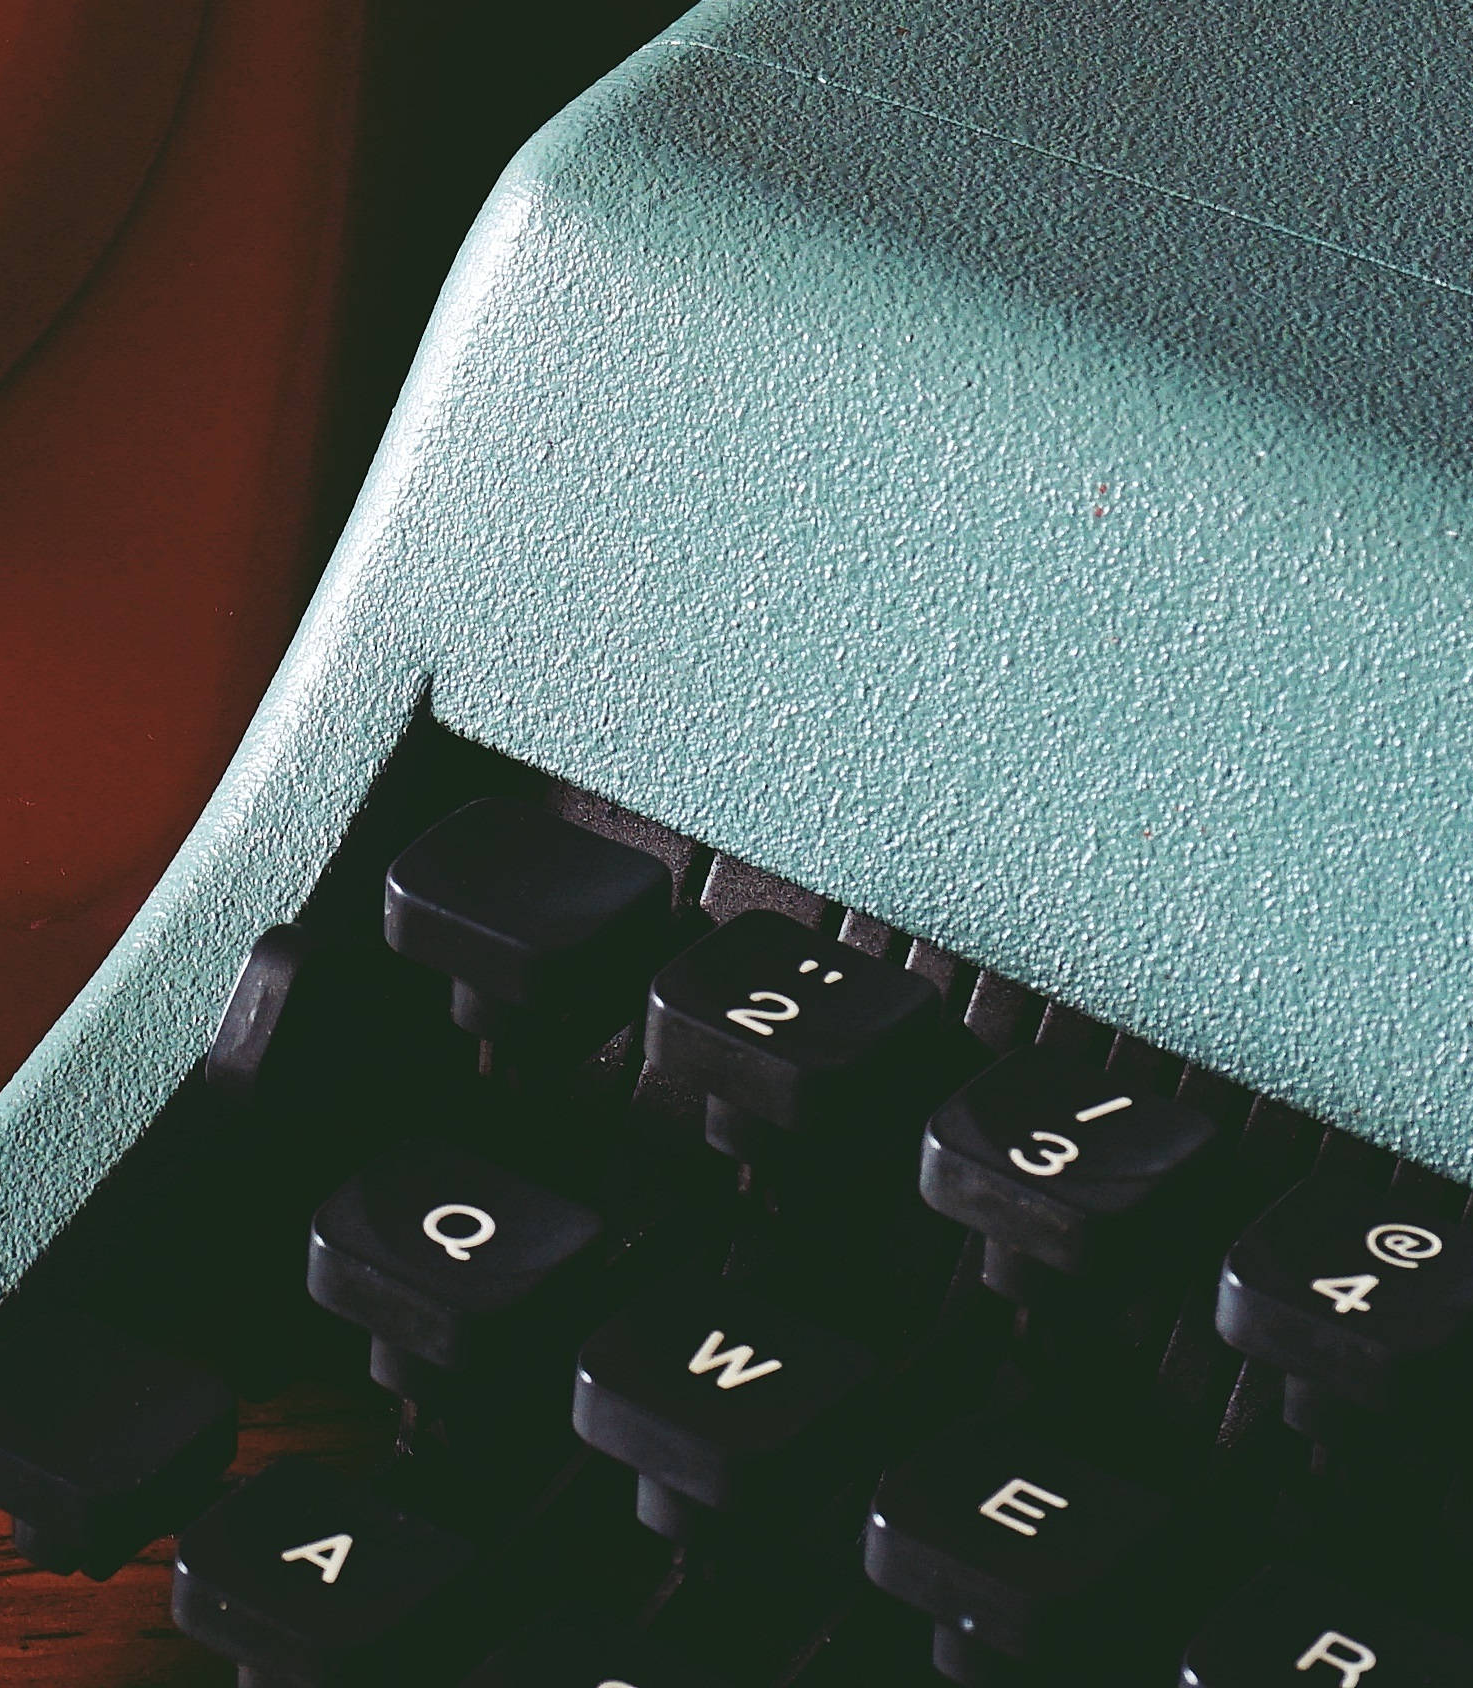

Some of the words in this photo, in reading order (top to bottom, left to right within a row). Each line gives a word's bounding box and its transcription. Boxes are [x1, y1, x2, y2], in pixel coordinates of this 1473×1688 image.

[725, 990, 801, 1037] 2
[1008, 1130, 1080, 1177] 3
[421, 1203, 497, 1262] Q
[1365, 1223, 1444, 1270] @
[1311, 1273, 1381, 1315] 4
[687, 1329, 784, 1390] W
[979, 1477, 1070, 1537] E
[280, 1533, 354, 1585] A
[1295, 1630, 1378, 1688] R
